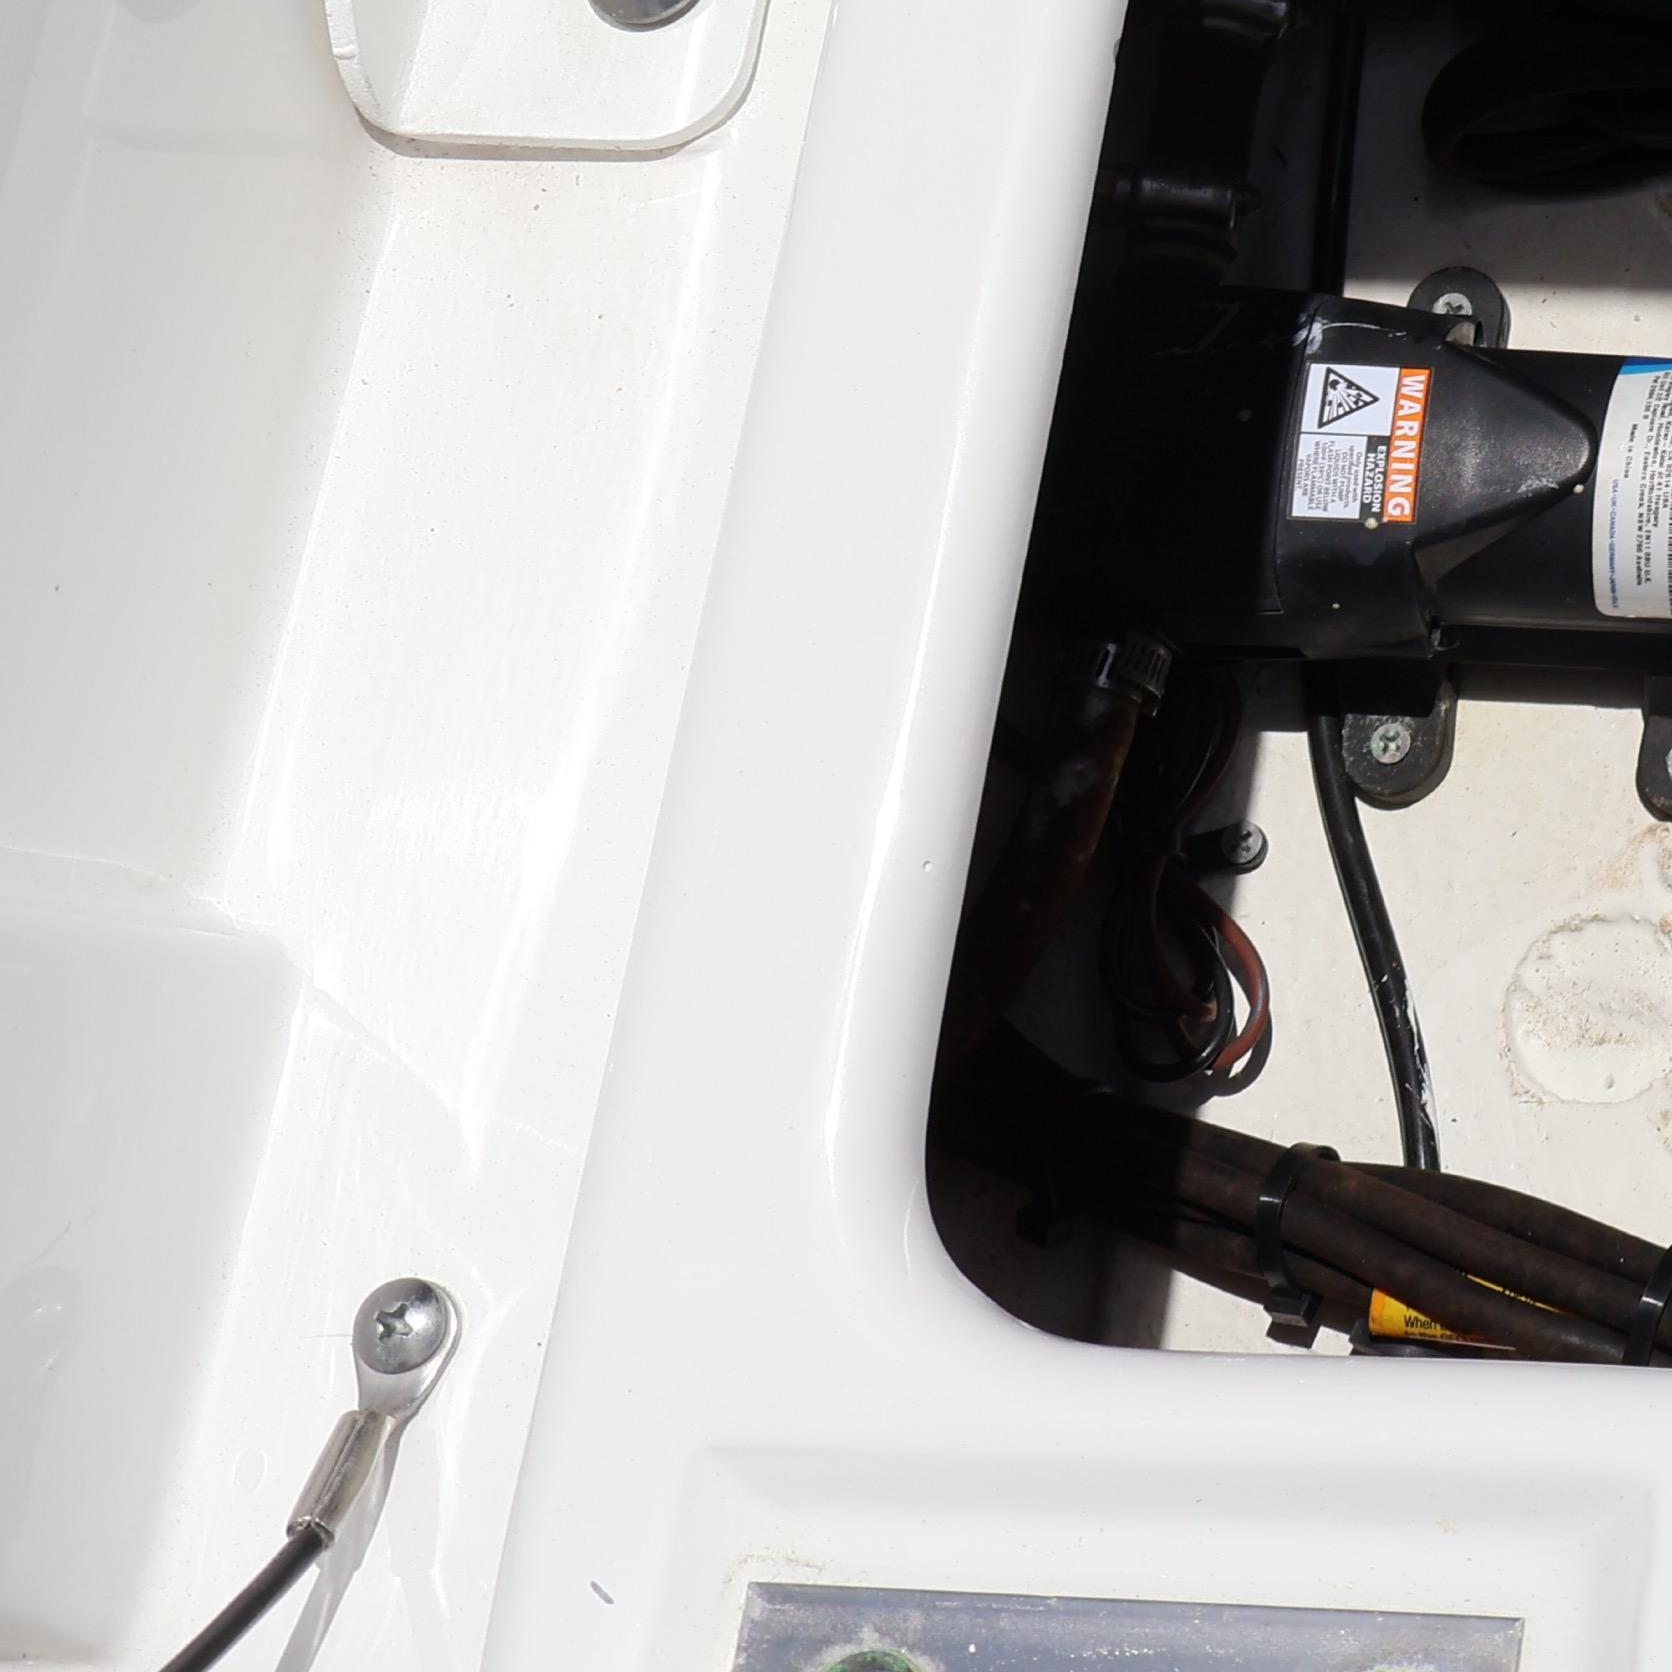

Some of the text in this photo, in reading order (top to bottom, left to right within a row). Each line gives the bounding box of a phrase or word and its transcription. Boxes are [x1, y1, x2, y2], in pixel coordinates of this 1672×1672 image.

[1361, 452, 1376, 504] HAZARD
[1370, 444, 1388, 513] EXPLOSION
[1386, 374, 1426, 517] WARNING
